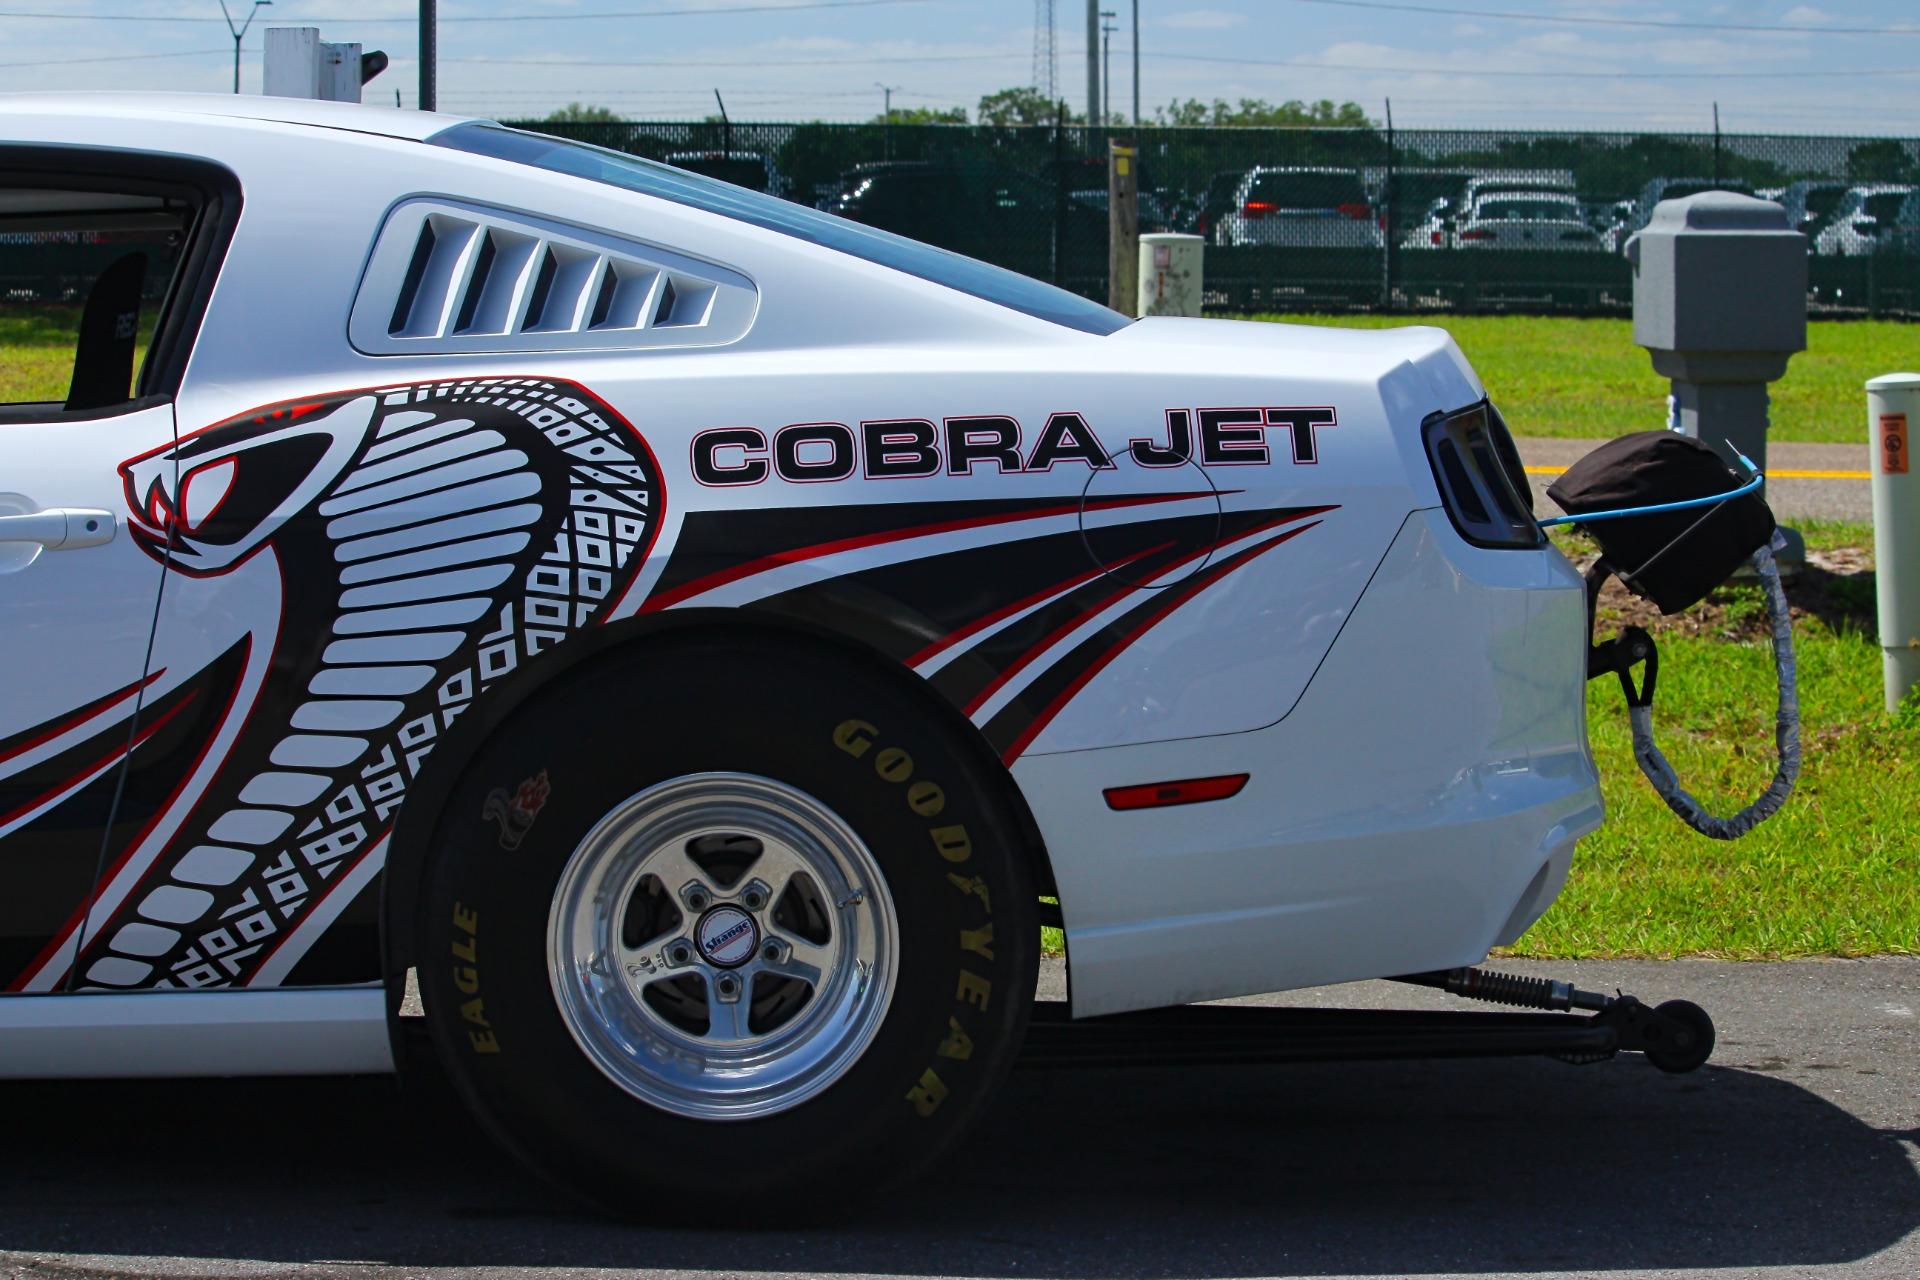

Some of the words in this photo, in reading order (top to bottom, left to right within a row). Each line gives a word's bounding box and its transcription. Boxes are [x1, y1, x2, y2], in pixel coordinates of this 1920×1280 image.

[690, 412, 1117, 488] COBRA
[1129, 406, 1337, 468] JET
[452, 900, 500, 1053] EAGLE
[704, 920, 750, 951] Strange
[832, 719, 995, 1117] GOODYEAR
